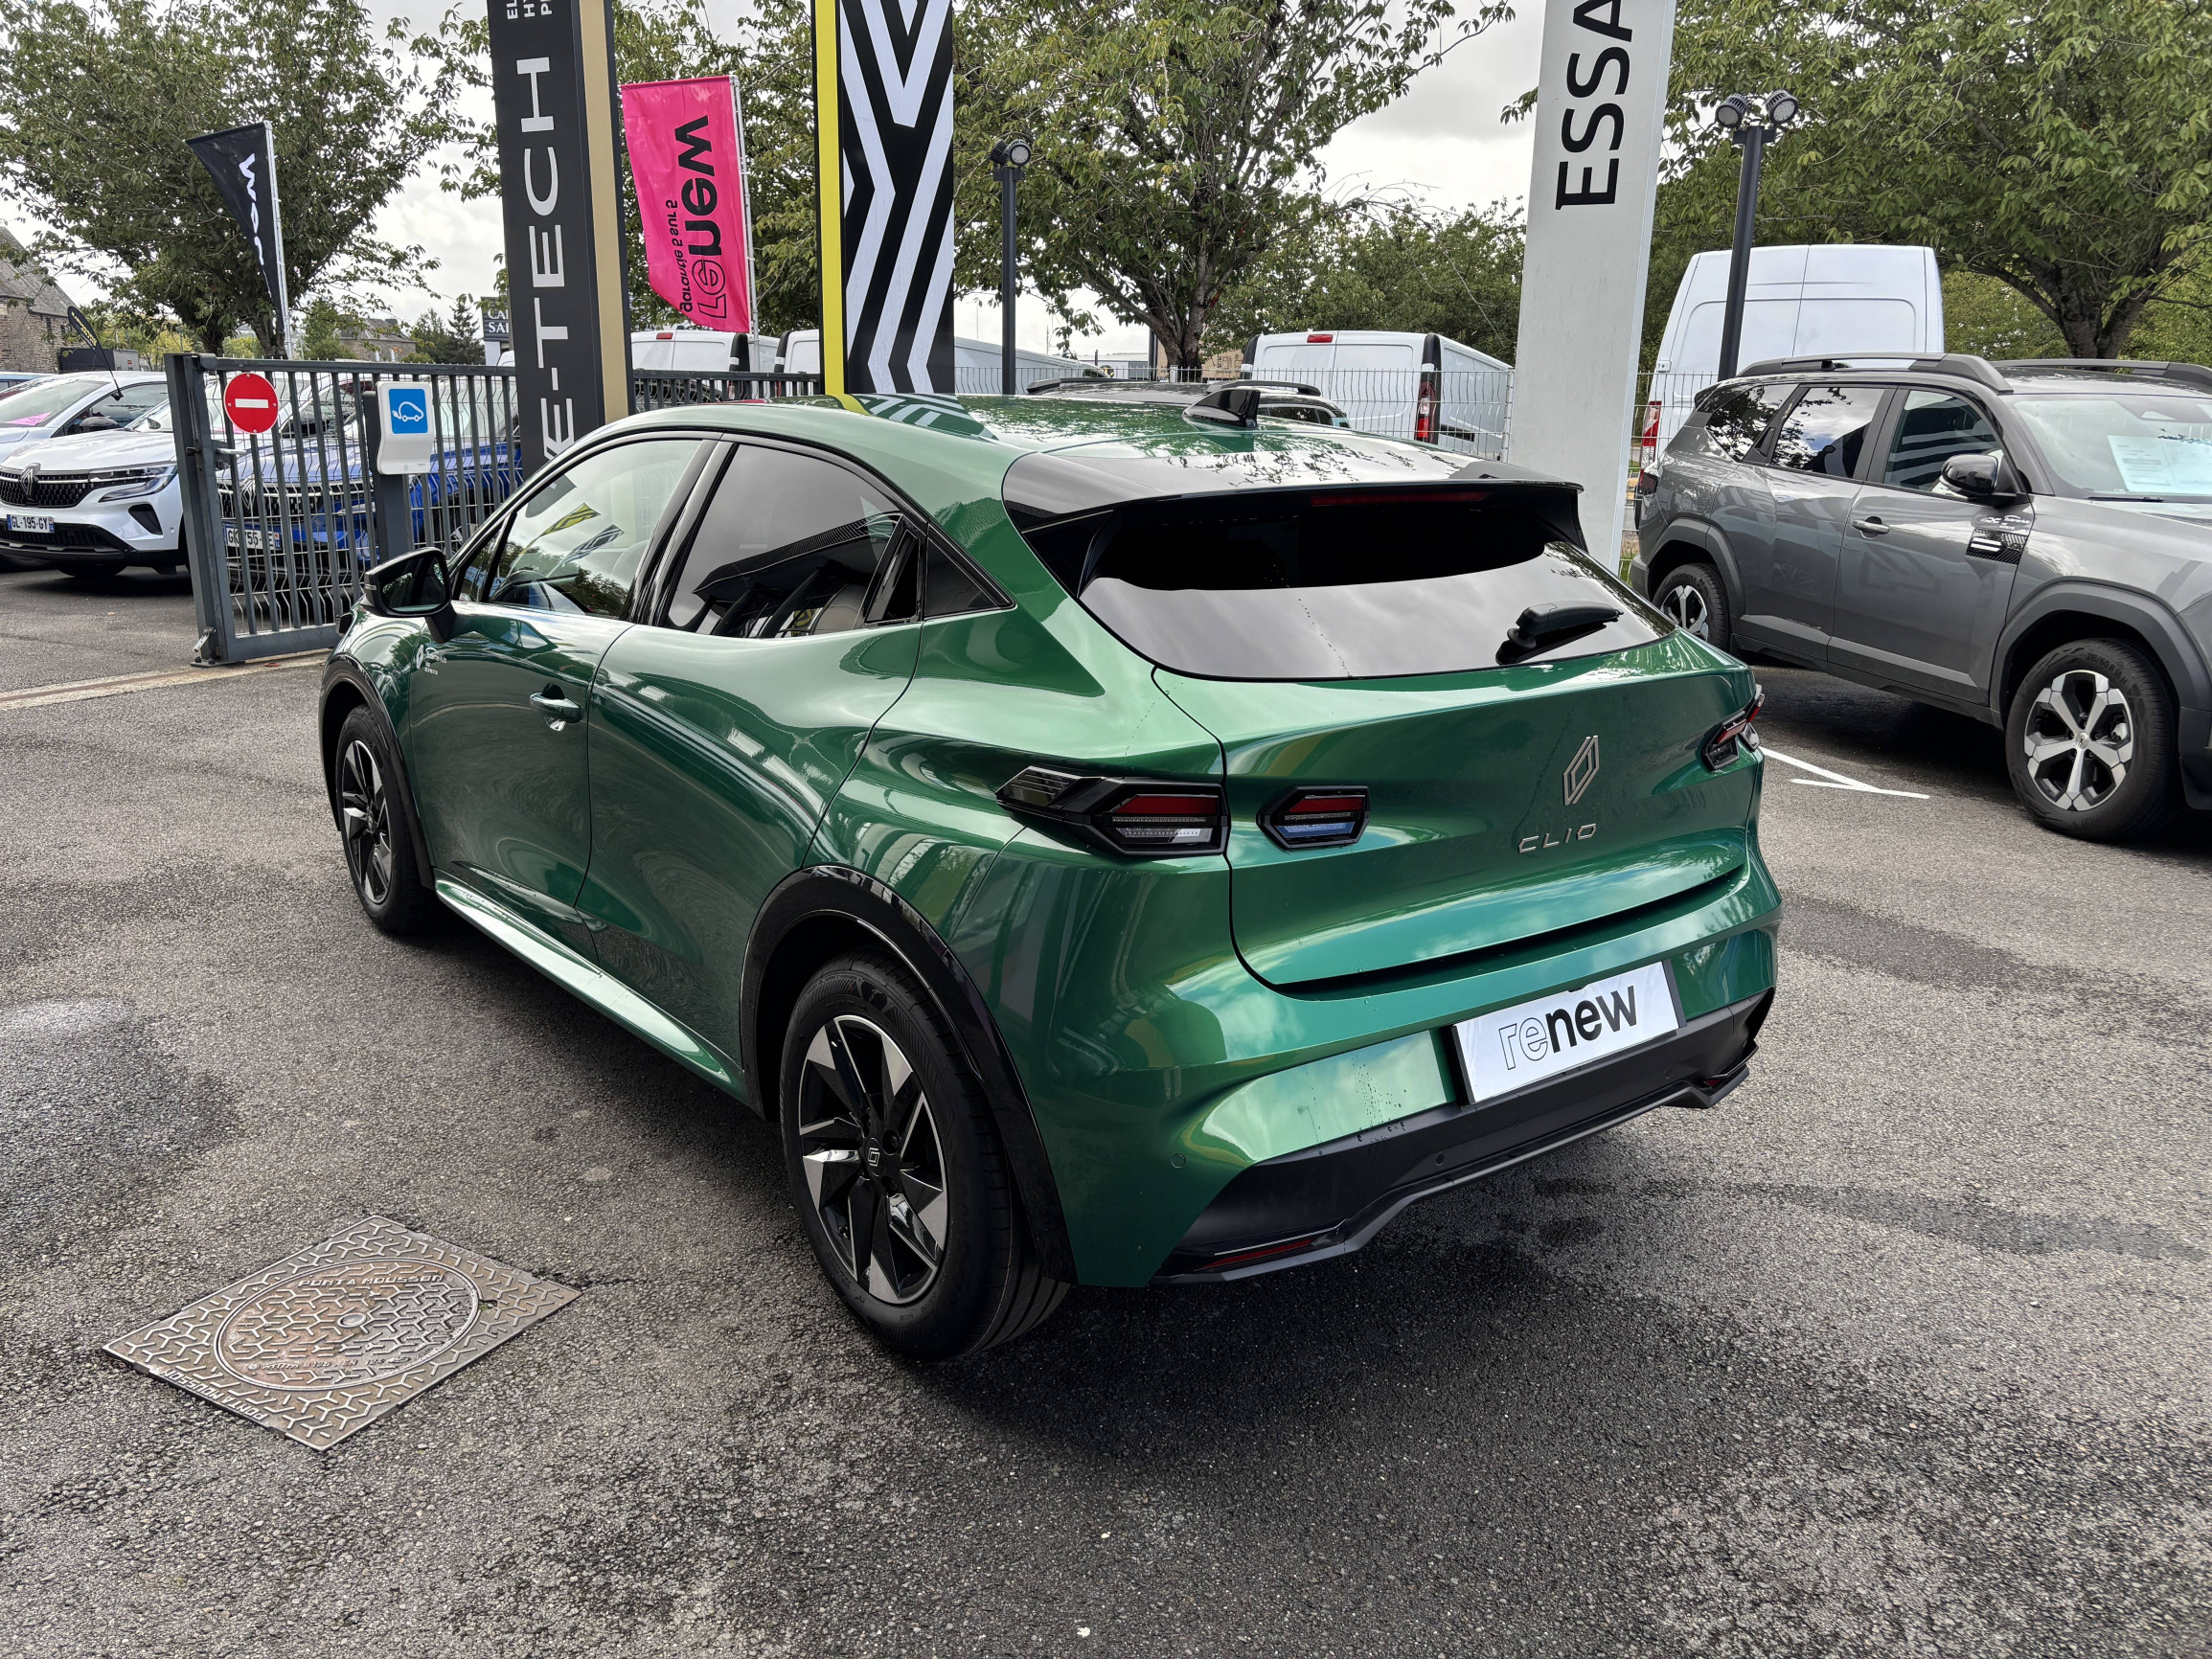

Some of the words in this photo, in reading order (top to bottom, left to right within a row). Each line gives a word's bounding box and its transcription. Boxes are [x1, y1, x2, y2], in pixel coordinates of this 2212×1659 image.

[516, 57, 575, 461] E-TECH
[11, 515, 48, 530] GL-195-GY
[1517, 823, 1597, 853] CLIO
[1498, 985, 1637, 1071] renew
[361, 1274, 445, 1285] MOUSSON
[161, 1368, 225, 1400] MOUSSON
